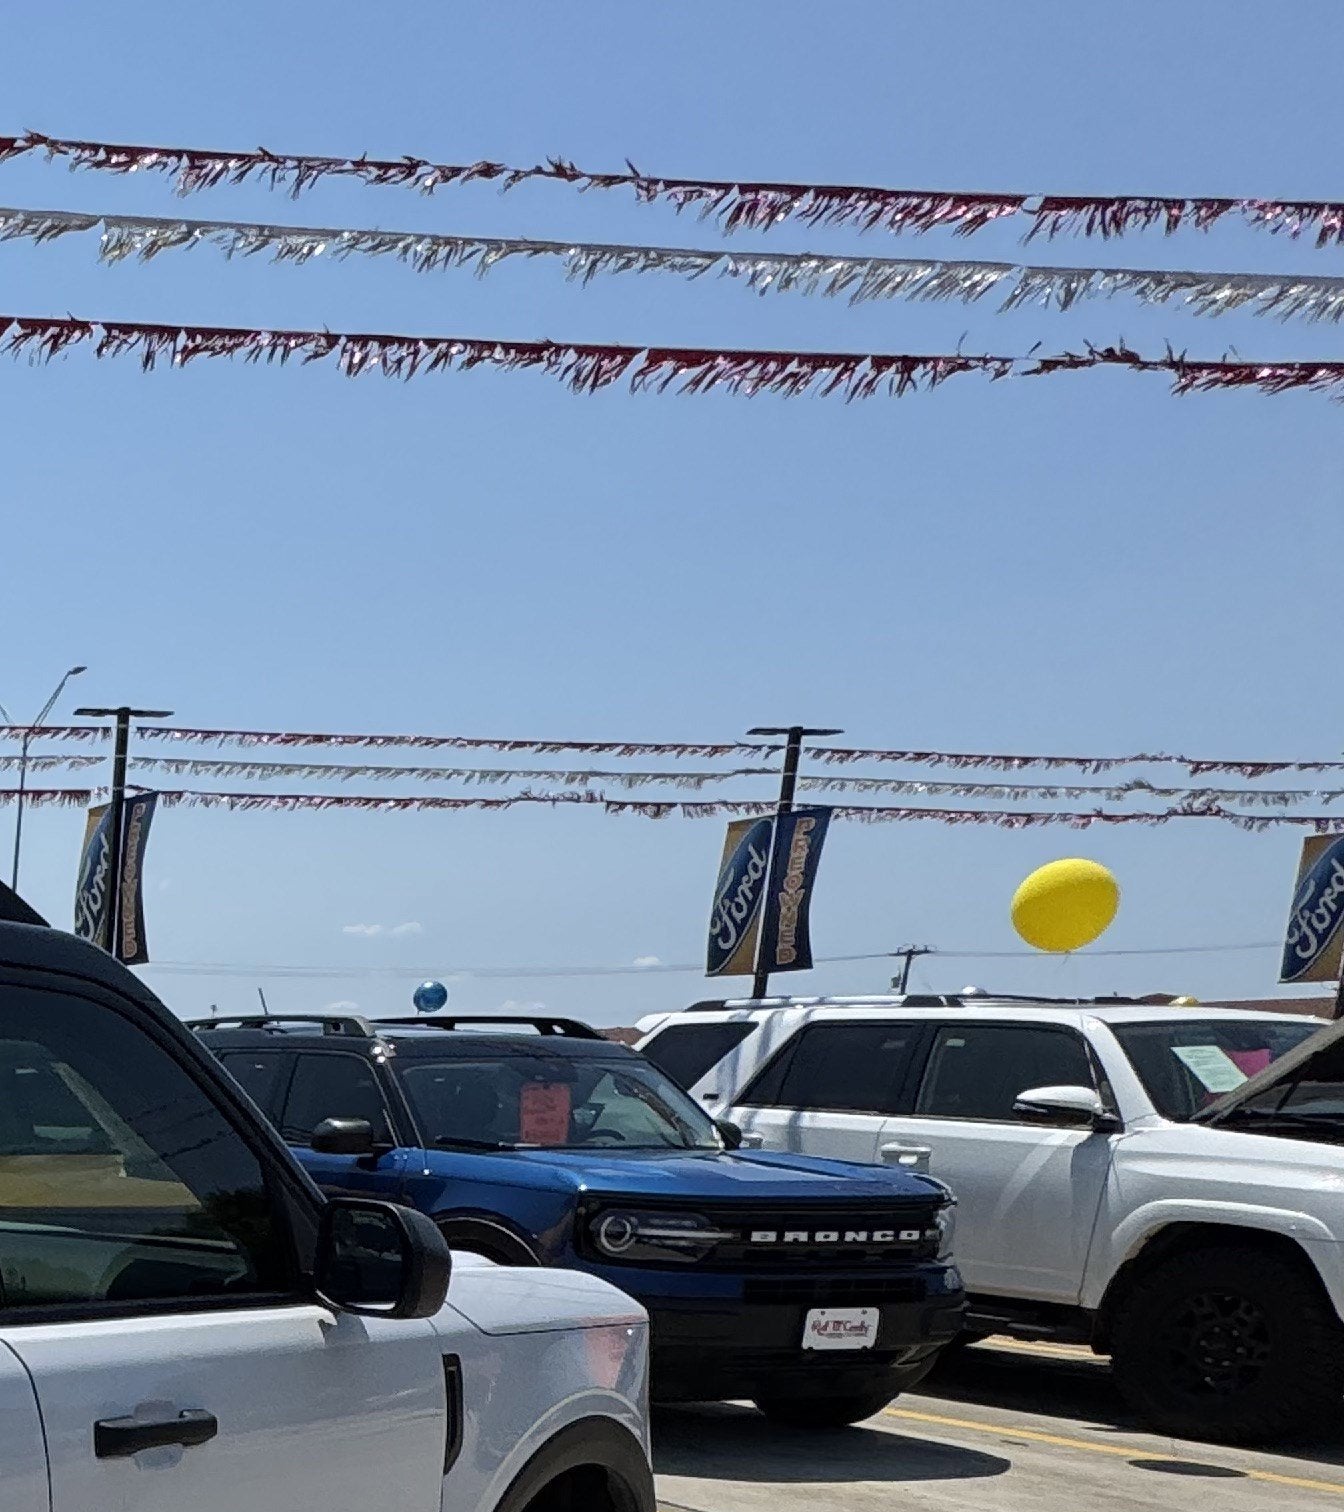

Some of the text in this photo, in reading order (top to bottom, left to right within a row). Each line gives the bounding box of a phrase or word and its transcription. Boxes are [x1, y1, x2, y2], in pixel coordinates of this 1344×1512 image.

[711, 843, 767, 950] Ford
[1287, 857, 1344, 959] Ford
[750, 1230, 920, 1242] BRONCO
